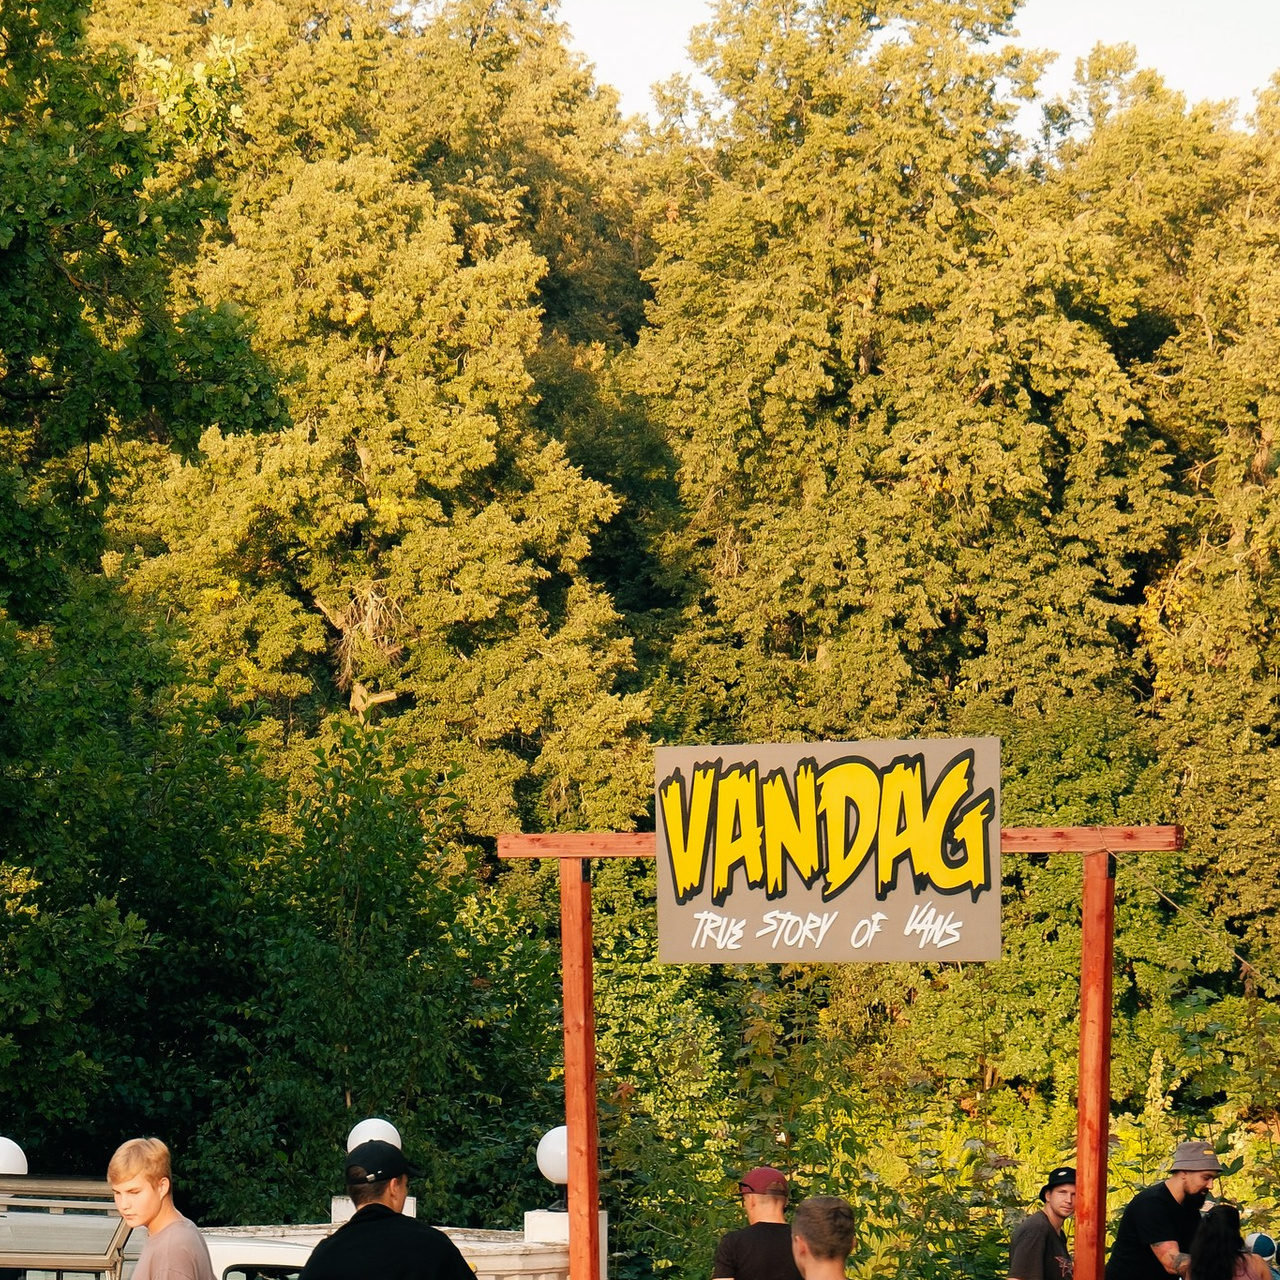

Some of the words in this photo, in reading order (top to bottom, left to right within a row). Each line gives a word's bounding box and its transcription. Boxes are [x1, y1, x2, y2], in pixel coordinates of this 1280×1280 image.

[659, 748, 995, 906] VANDAG
[691, 910, 746, 949] TRUE
[755, 910, 838, 949] STORY
[850, 911, 889, 948] OF
[903, 901, 963, 949] VANS
